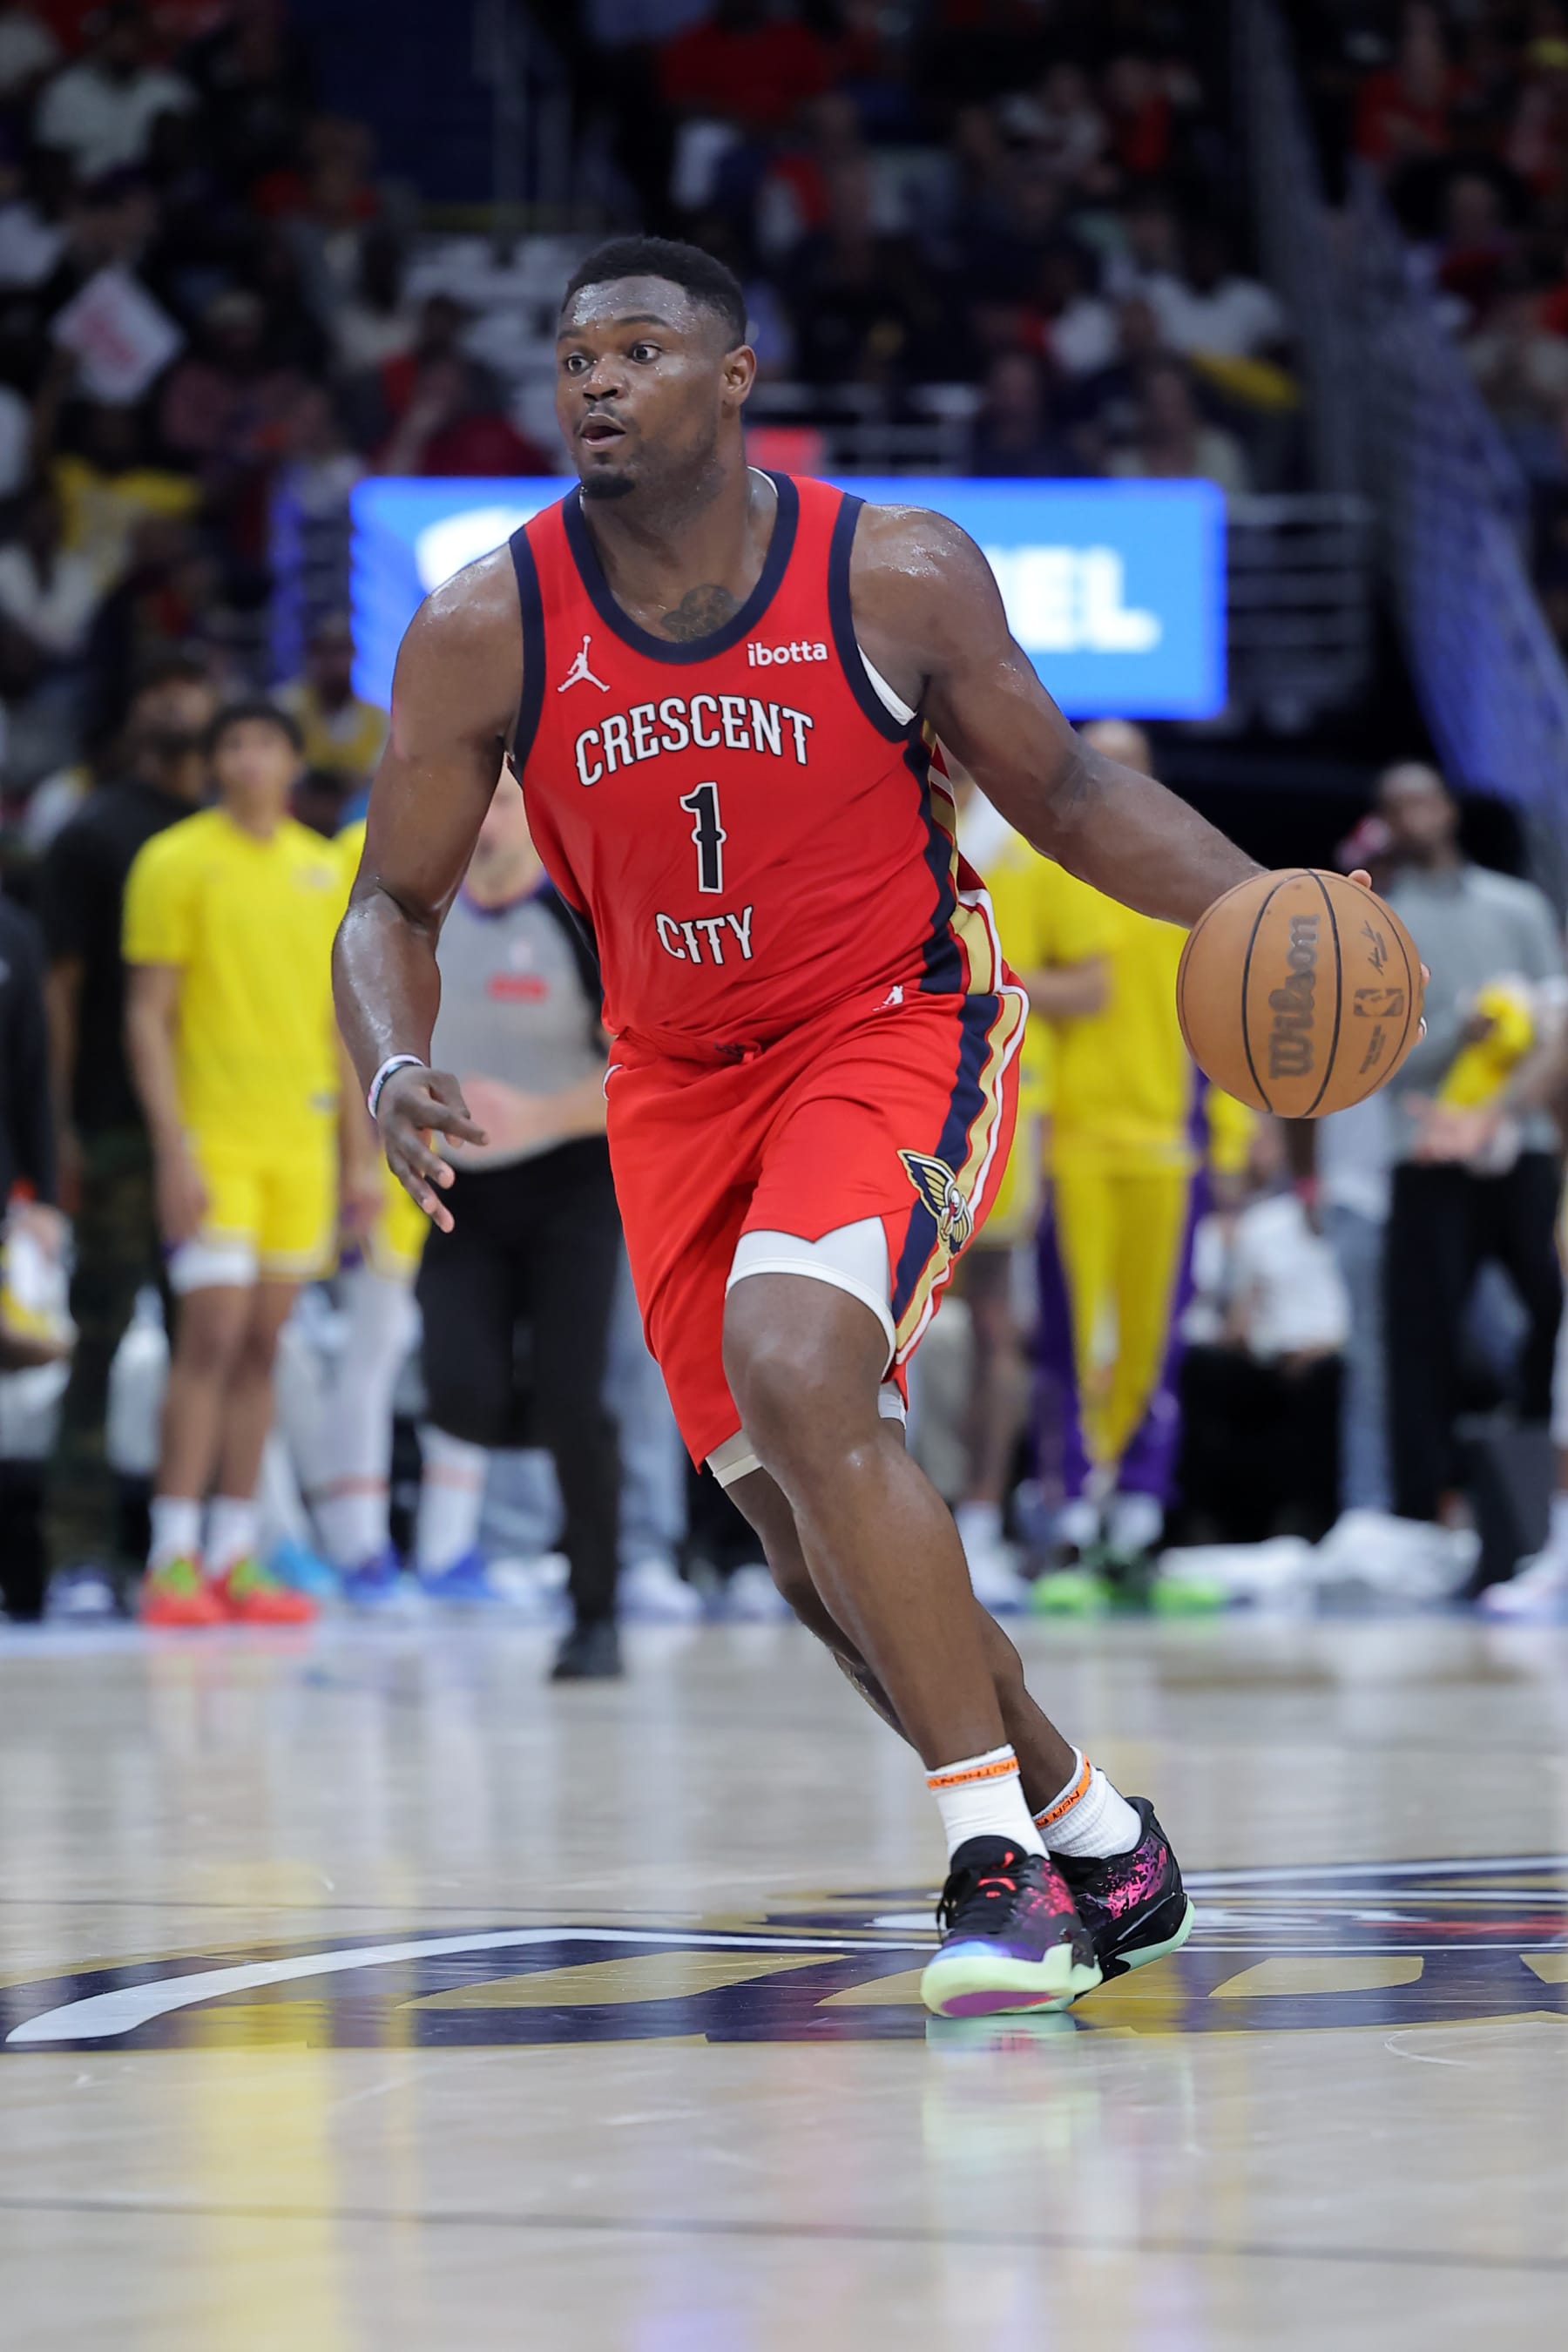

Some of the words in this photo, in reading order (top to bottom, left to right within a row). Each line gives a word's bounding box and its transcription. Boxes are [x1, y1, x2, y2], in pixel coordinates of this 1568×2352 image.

[747, 641, 828, 667] ibotta
[575, 694, 814, 787] CRESCENT
[679, 781, 727, 894] 1
[655, 906, 754, 965] CITY
[1267, 915, 1320, 1079] Wilson
